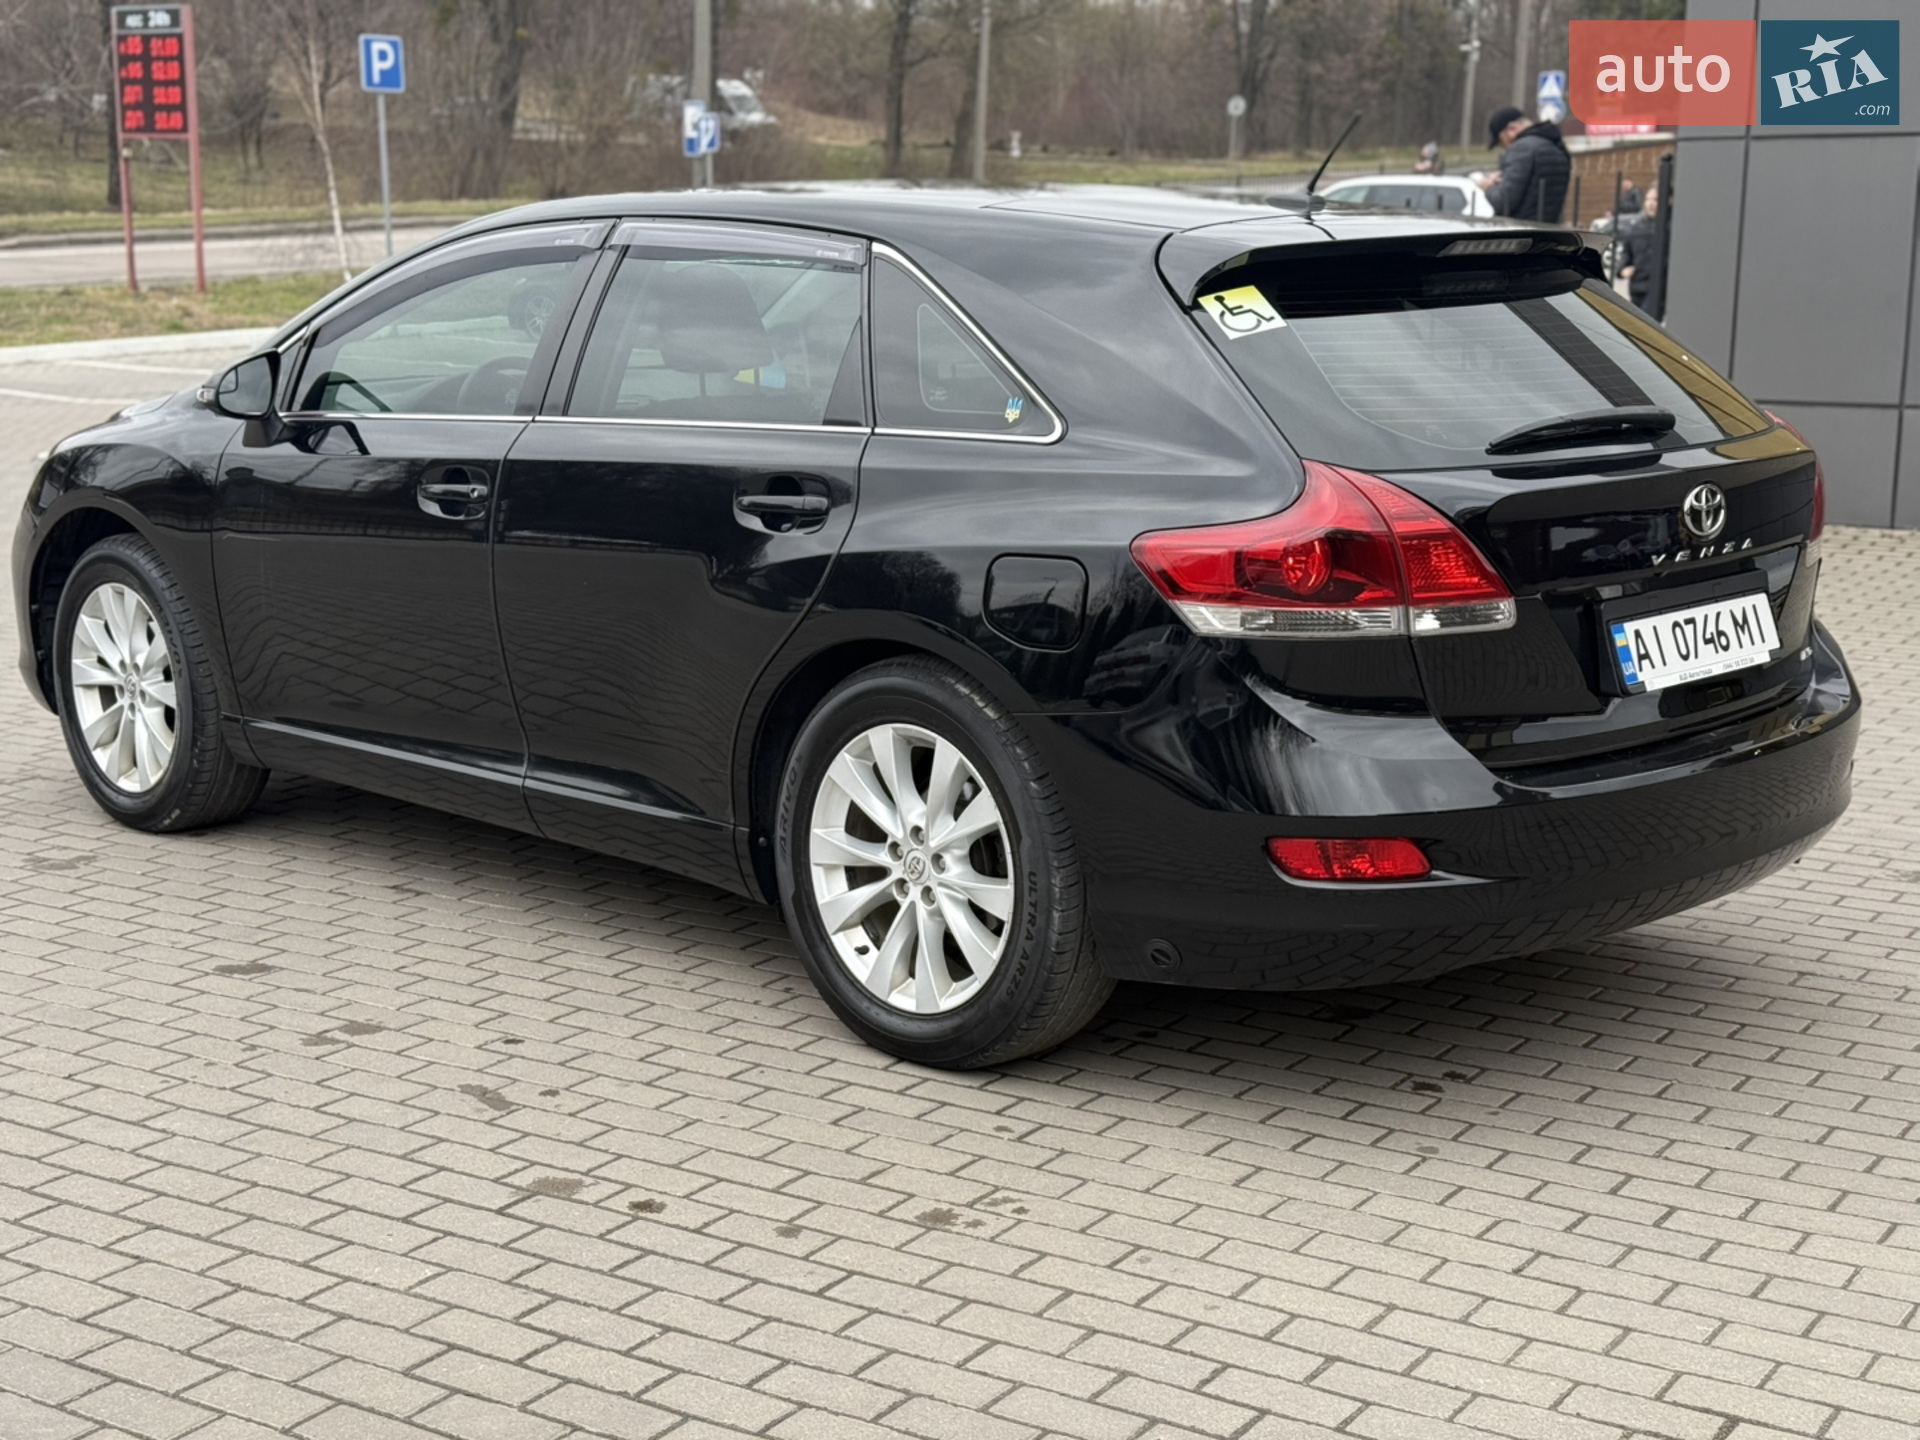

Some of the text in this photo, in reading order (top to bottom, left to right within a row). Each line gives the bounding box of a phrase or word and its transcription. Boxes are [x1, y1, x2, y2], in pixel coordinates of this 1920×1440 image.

[371, 41, 395, 85] P
[1651, 538, 1752, 566] VENZA
[1633, 604, 1766, 672] AI 0746 MI
[1622, 661, 1636, 676] UA
[780, 765, 798, 857] ARIVO
[1006, 870, 1038, 1000] ULTRA ARZ5
